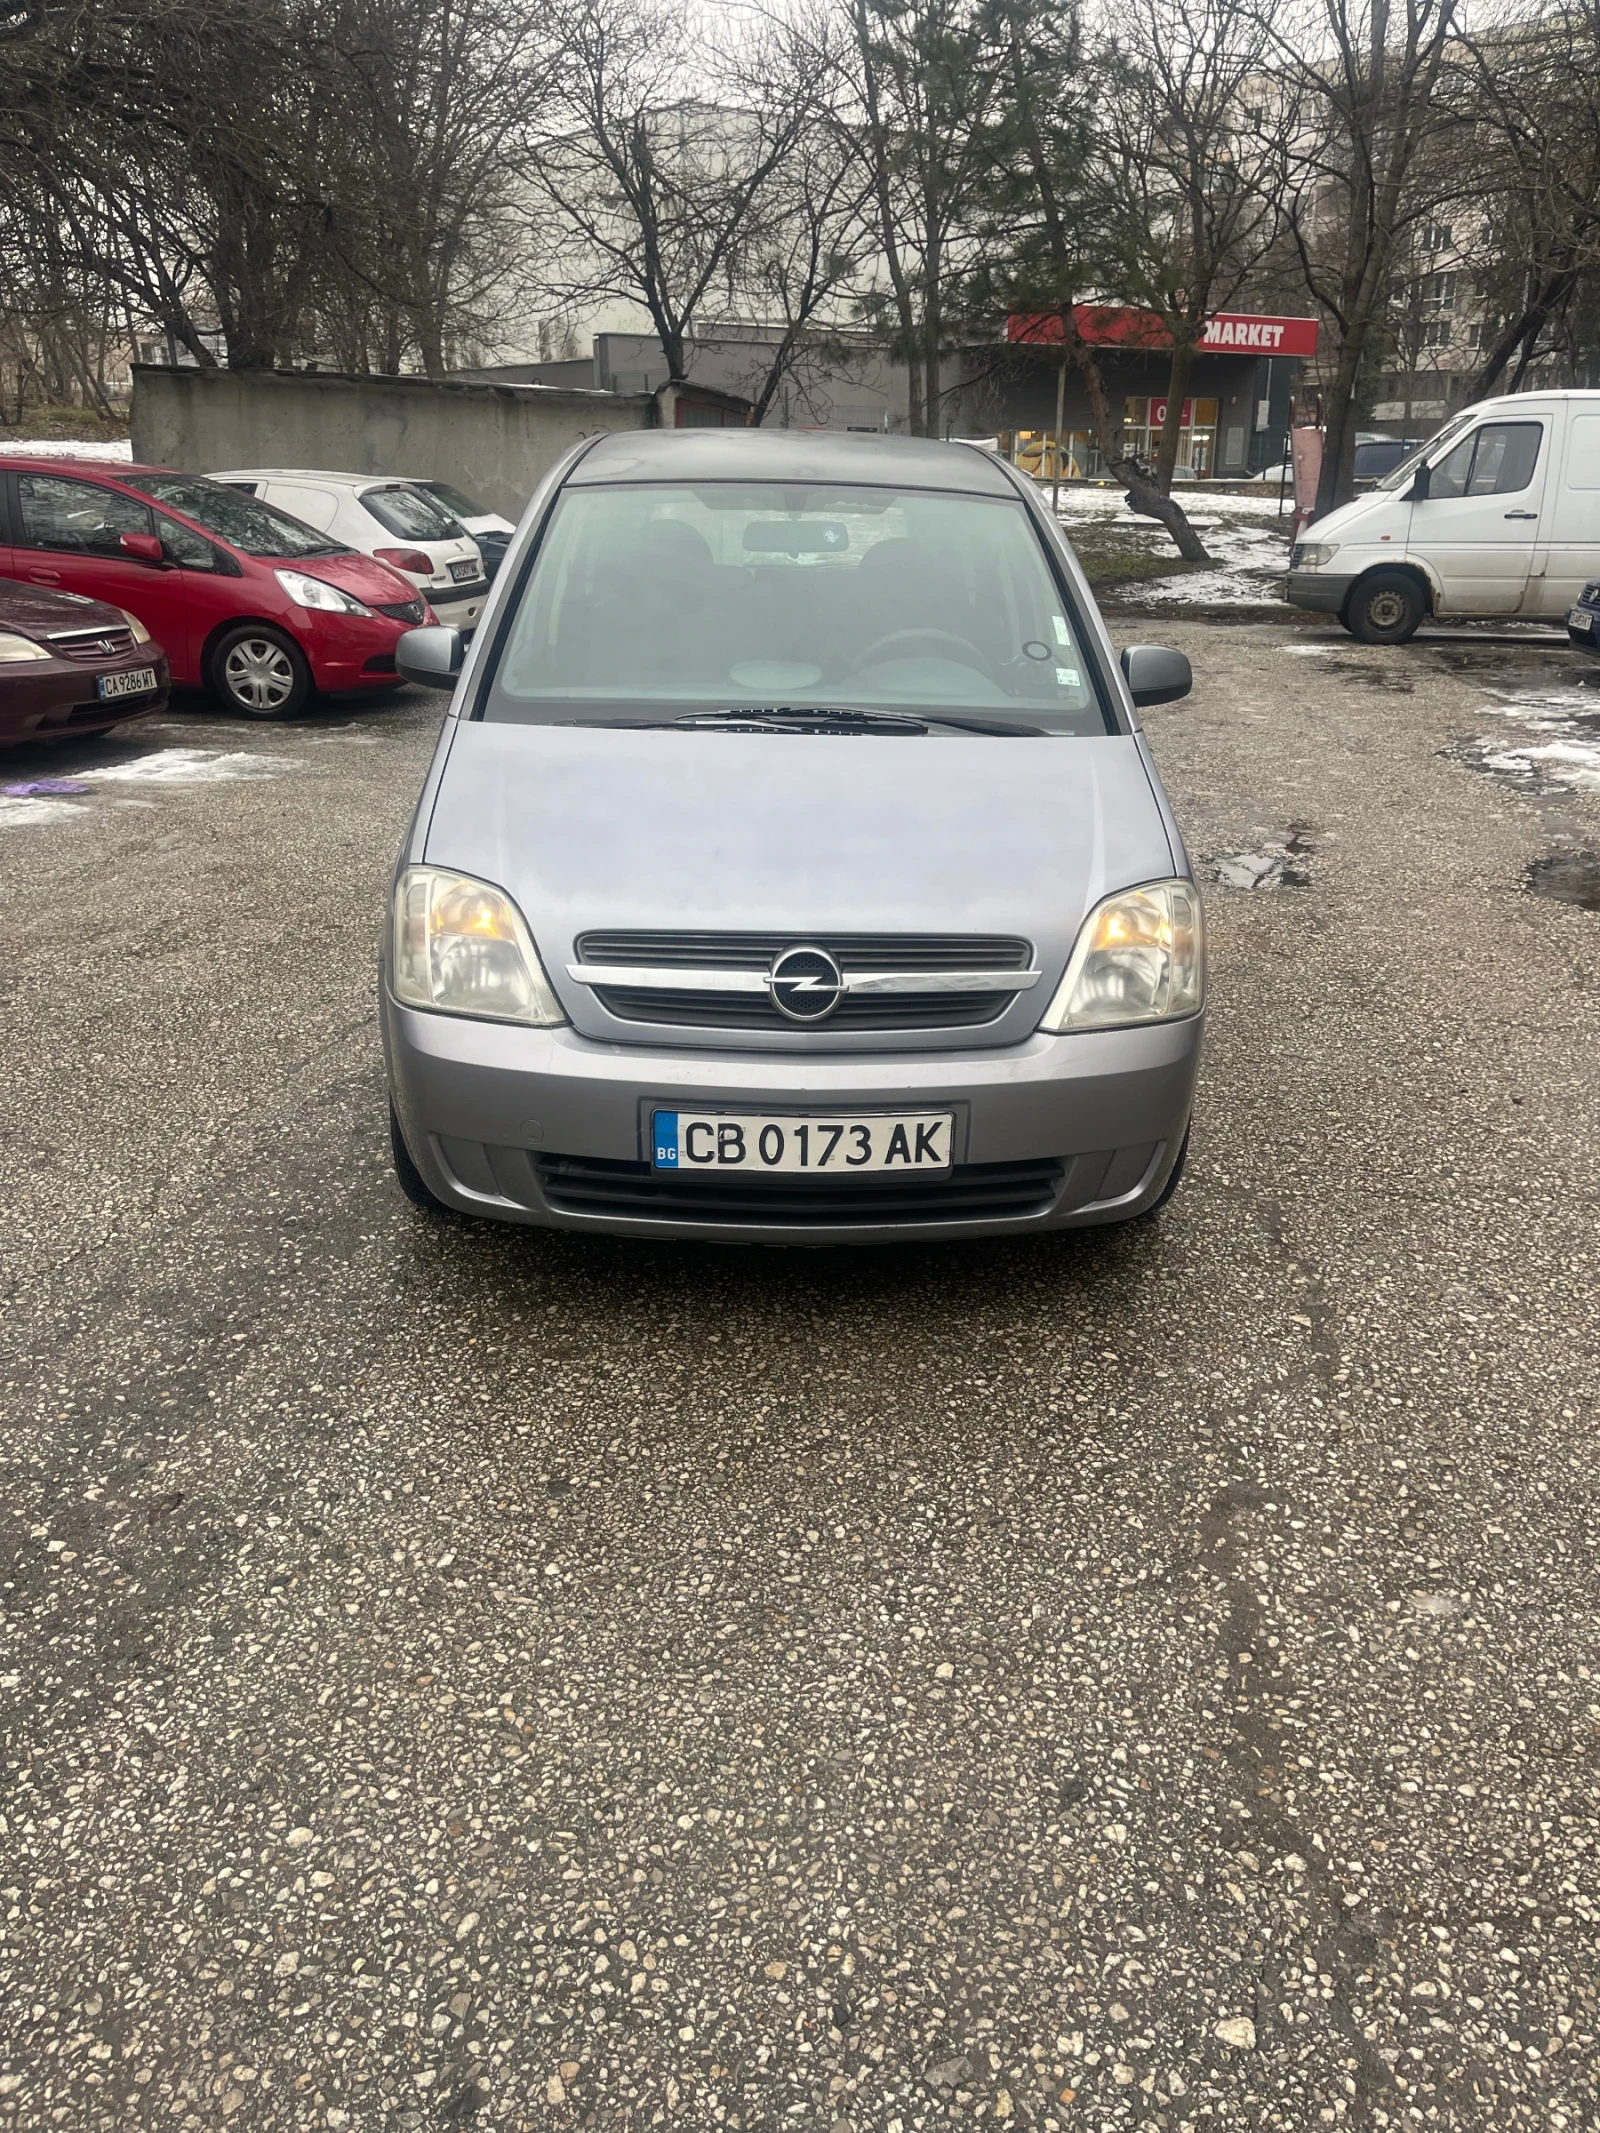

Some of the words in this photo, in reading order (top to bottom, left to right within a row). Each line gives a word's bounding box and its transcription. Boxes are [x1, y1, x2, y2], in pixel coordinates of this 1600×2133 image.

[1203, 321, 1284, 347] MARKET
[105, 678, 119, 695] CA
[119, 673, 142, 692] 9286
[657, 1147, 676, 1160] BG
[686, 1121, 746, 1164] CB
[759, 1123, 872, 1166] 0173
[884, 1121, 943, 1164] AK
